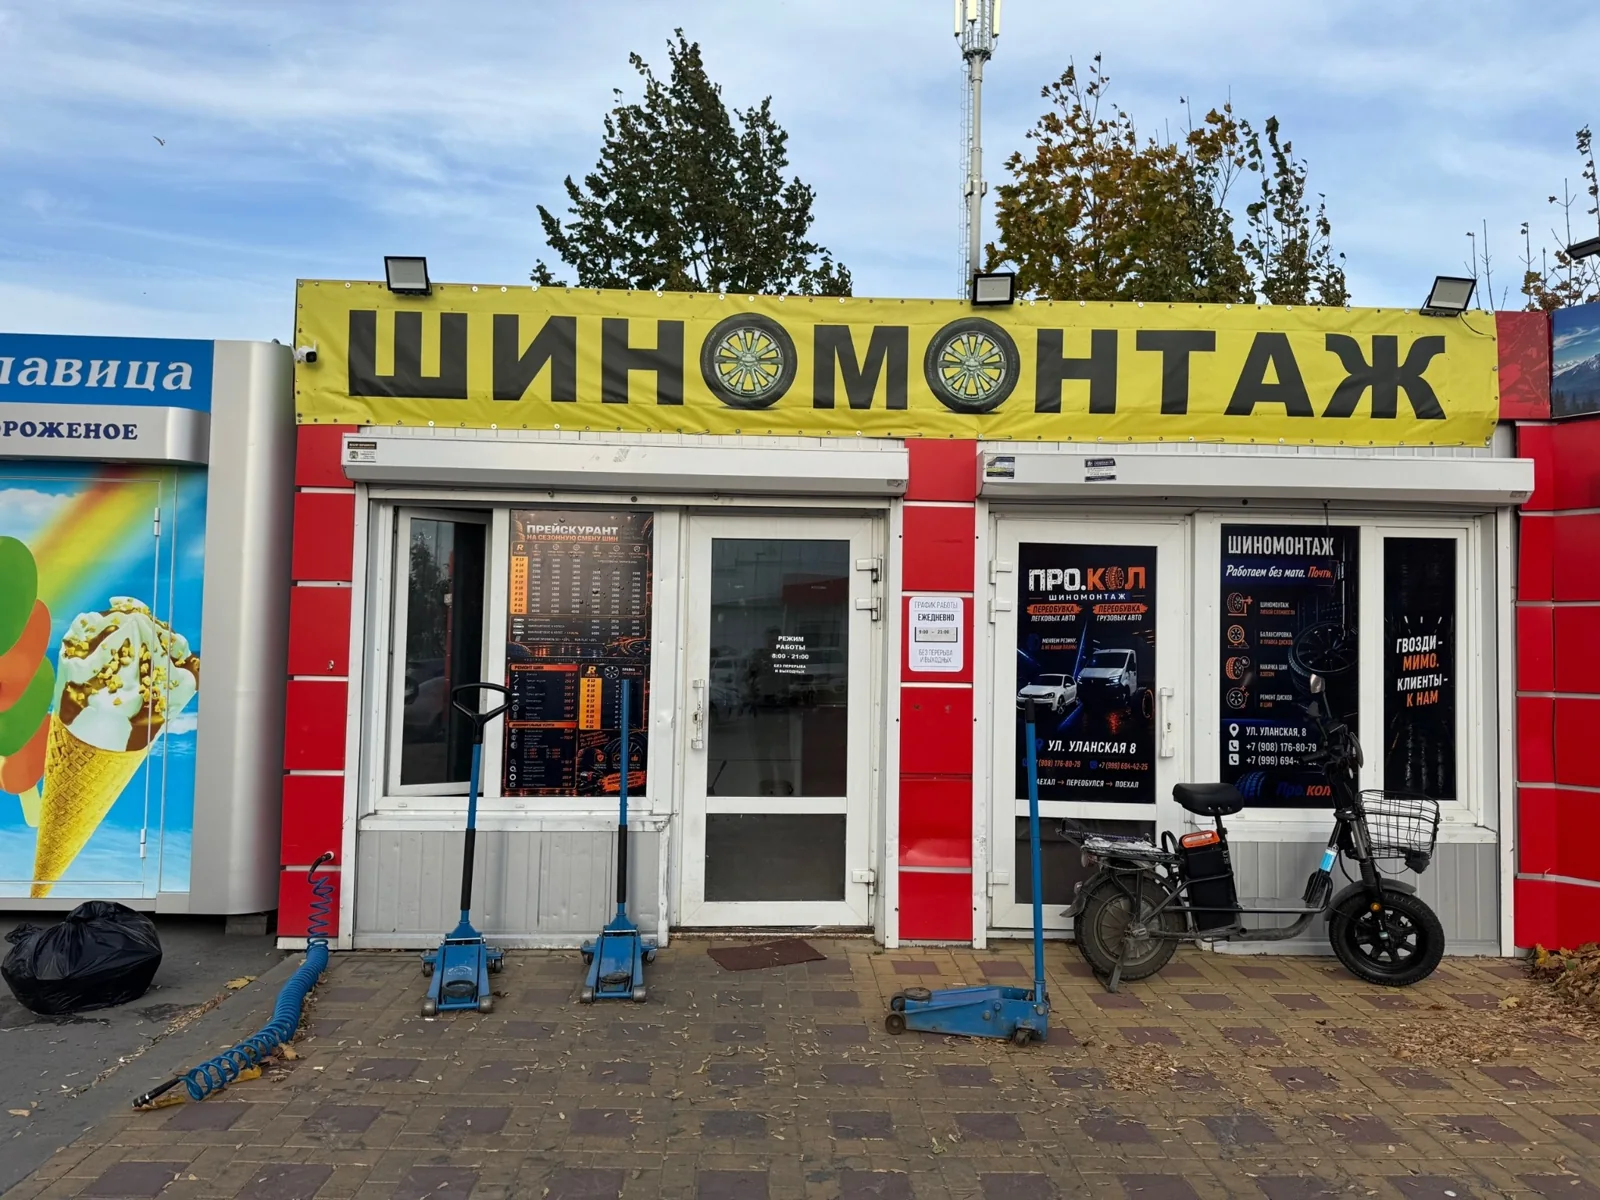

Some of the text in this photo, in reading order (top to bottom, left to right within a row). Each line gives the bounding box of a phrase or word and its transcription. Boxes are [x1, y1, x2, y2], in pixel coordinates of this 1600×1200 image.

[349, 310, 1445, 419] ШИНОМОНТАЖ
[0, 420, 138, 440] РОЖЕНОЕ
[526, 523, 618, 535] ПРЕЙСКУРАНТ
[1228, 535, 1334, 556] ШИНОМОНТАЖ
[1226, 564, 1267, 576] Работаем
[1269, 566, 1282, 577] без
[1284, 568, 1305, 577] мата.
[1307, 566, 1333, 578] Почти.
[1049, 593, 1126, 601] ШИНОМОНТАЖ
[914, 601, 957, 609] ГРАФИК РАБОТЫ
[1033, 604, 1074, 613] ПЕРЕОБУВКА
[1098, 603, 1141, 613] ПЕРЕОБУВКА
[918, 613, 954, 621] ЕЖЕДНЕВНО
[1403, 652, 1439, 671] МИМО.
[1406, 690, 1438, 707] К НАМ
[1246, 727, 1307, 738] УЛ. УЛАНСКАЯ, 8
[1048, 740, 1137, 754] УЛ. УЛАНСКАЯ 8
[1246, 742, 1317, 752] +7 (908) 176-80-79
[1246, 756, 1256, 765] +7
[1258, 756, 1278, 766] (999)
[1066, 779, 1104, 787] ПЕРЕОБУЛСЯ
